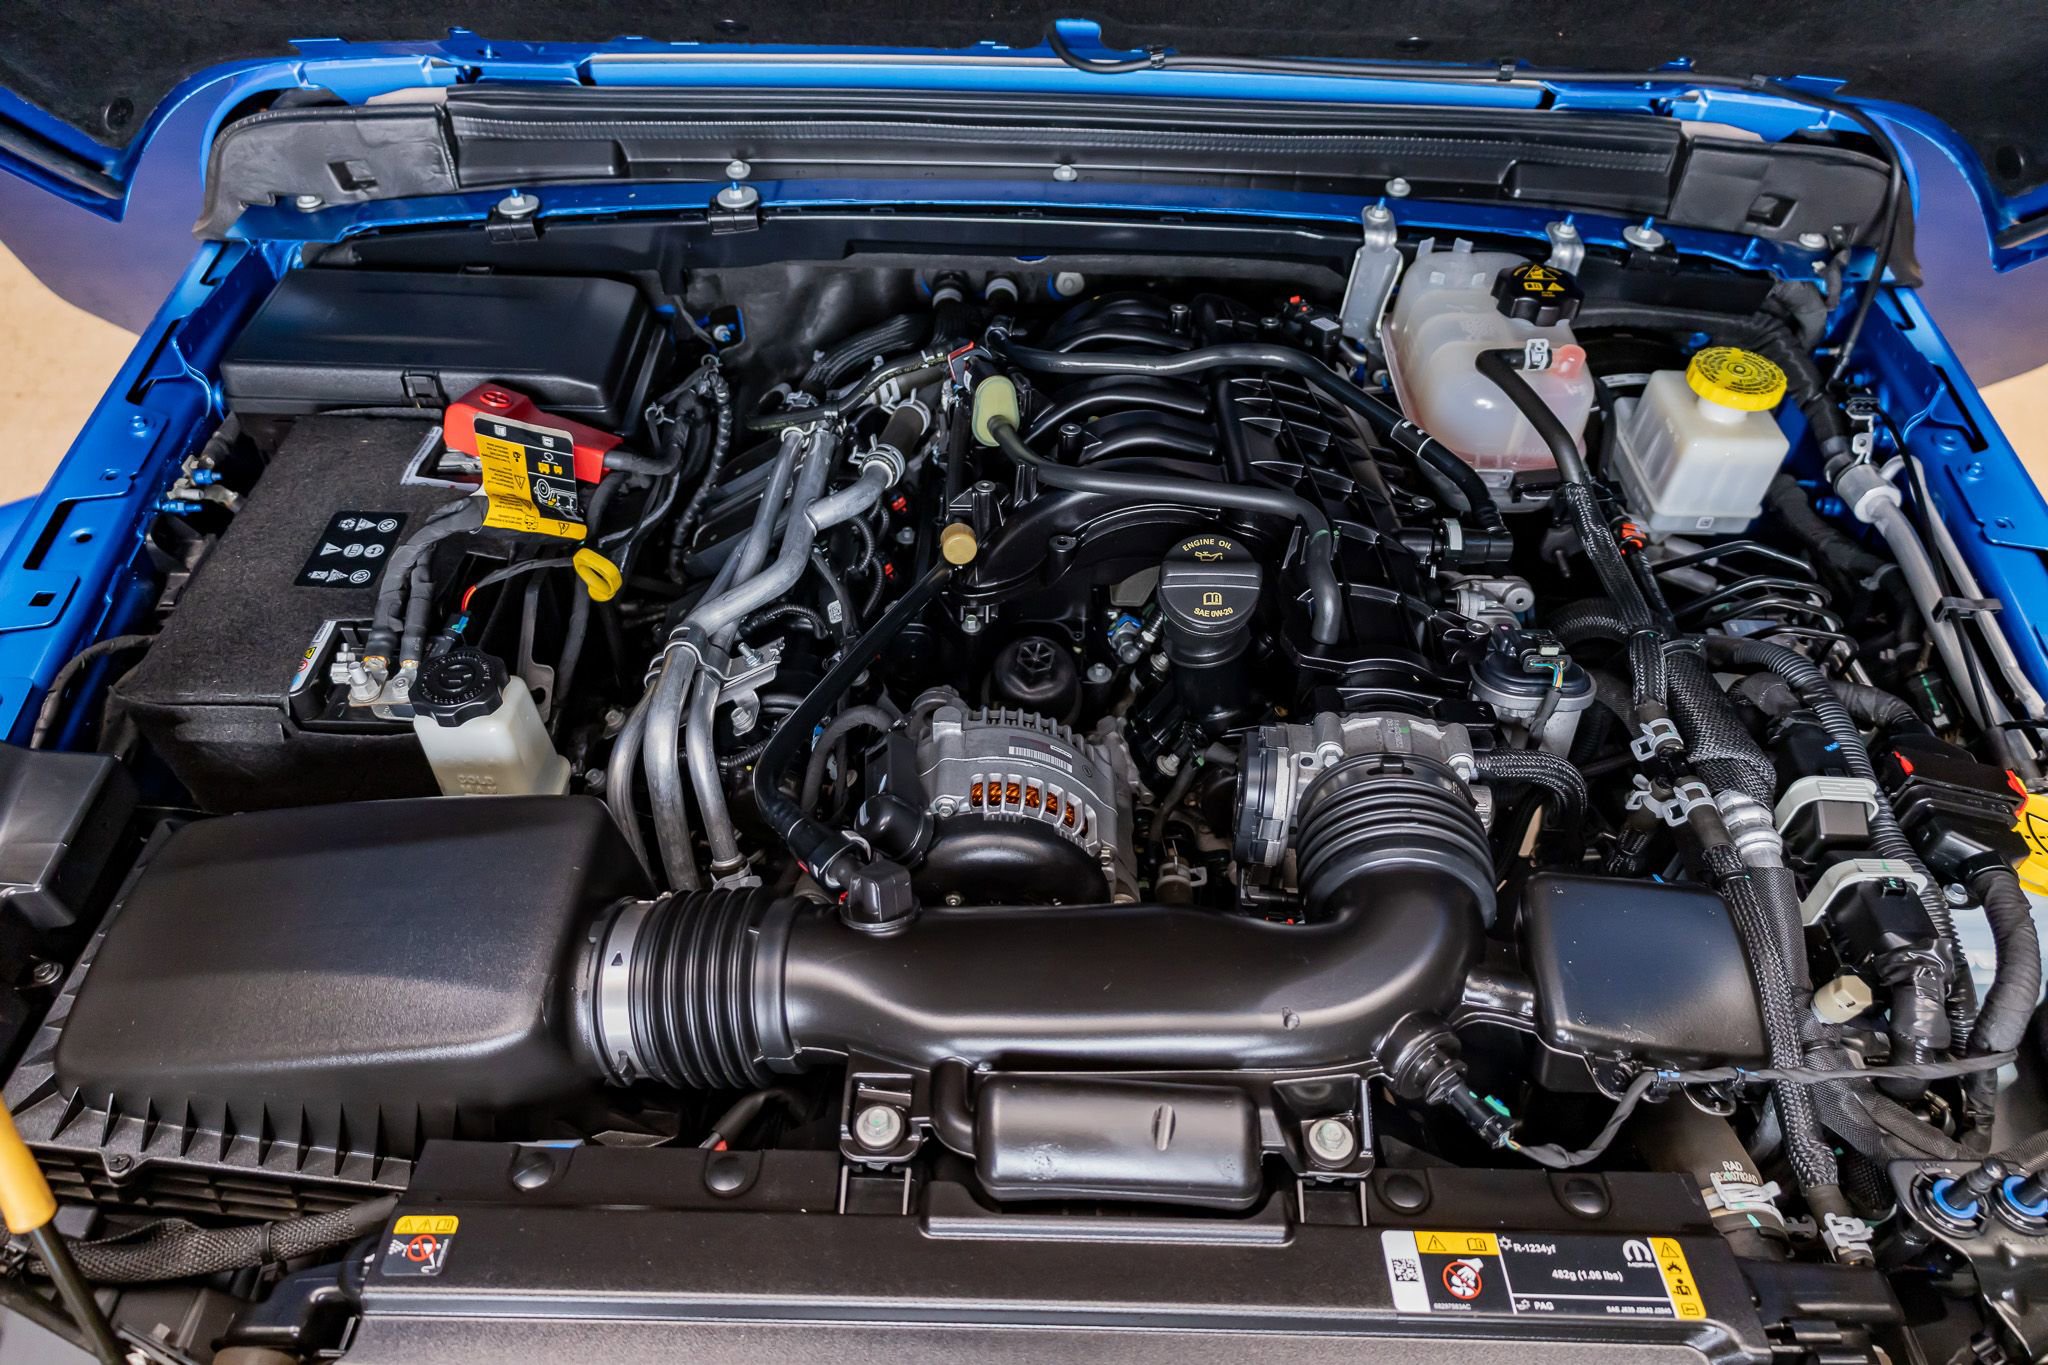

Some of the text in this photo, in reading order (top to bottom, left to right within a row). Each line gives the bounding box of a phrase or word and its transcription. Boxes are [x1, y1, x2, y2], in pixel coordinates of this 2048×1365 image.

[1182, 539, 1232, 551] ENGINE OIL
[1193, 607, 1233, 618] SAE 0W-20
[1722, 1160, 1744, 1172] RAD
[1513, 1243, 1557, 1256] R-1234yf
[1602, 1270, 1624, 1283] lbs)
[1533, 1300, 1555, 1311] PAG
